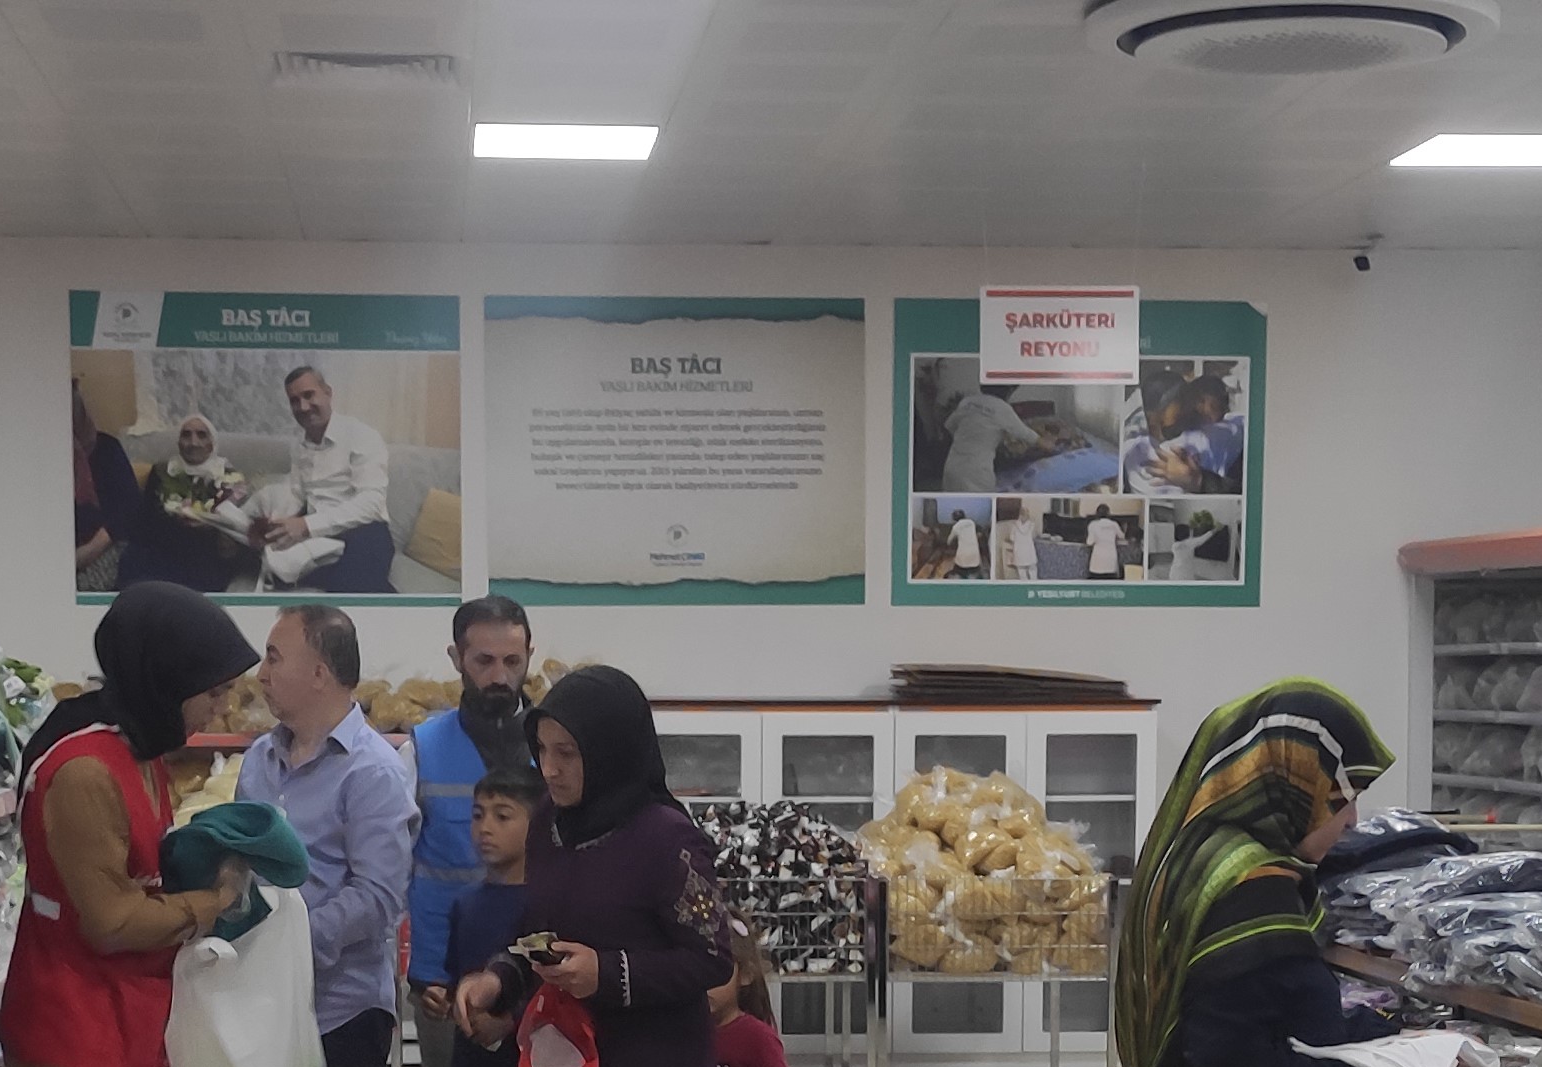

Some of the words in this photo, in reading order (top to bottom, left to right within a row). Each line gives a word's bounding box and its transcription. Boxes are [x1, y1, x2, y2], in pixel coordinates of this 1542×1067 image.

[222, 309, 262, 329] BAŞ
[1005, 308, 1115, 334] ŞARKÜTERİ
[1020, 341, 1100, 357] REYONU
[631, 357, 672, 379] BAŞ
